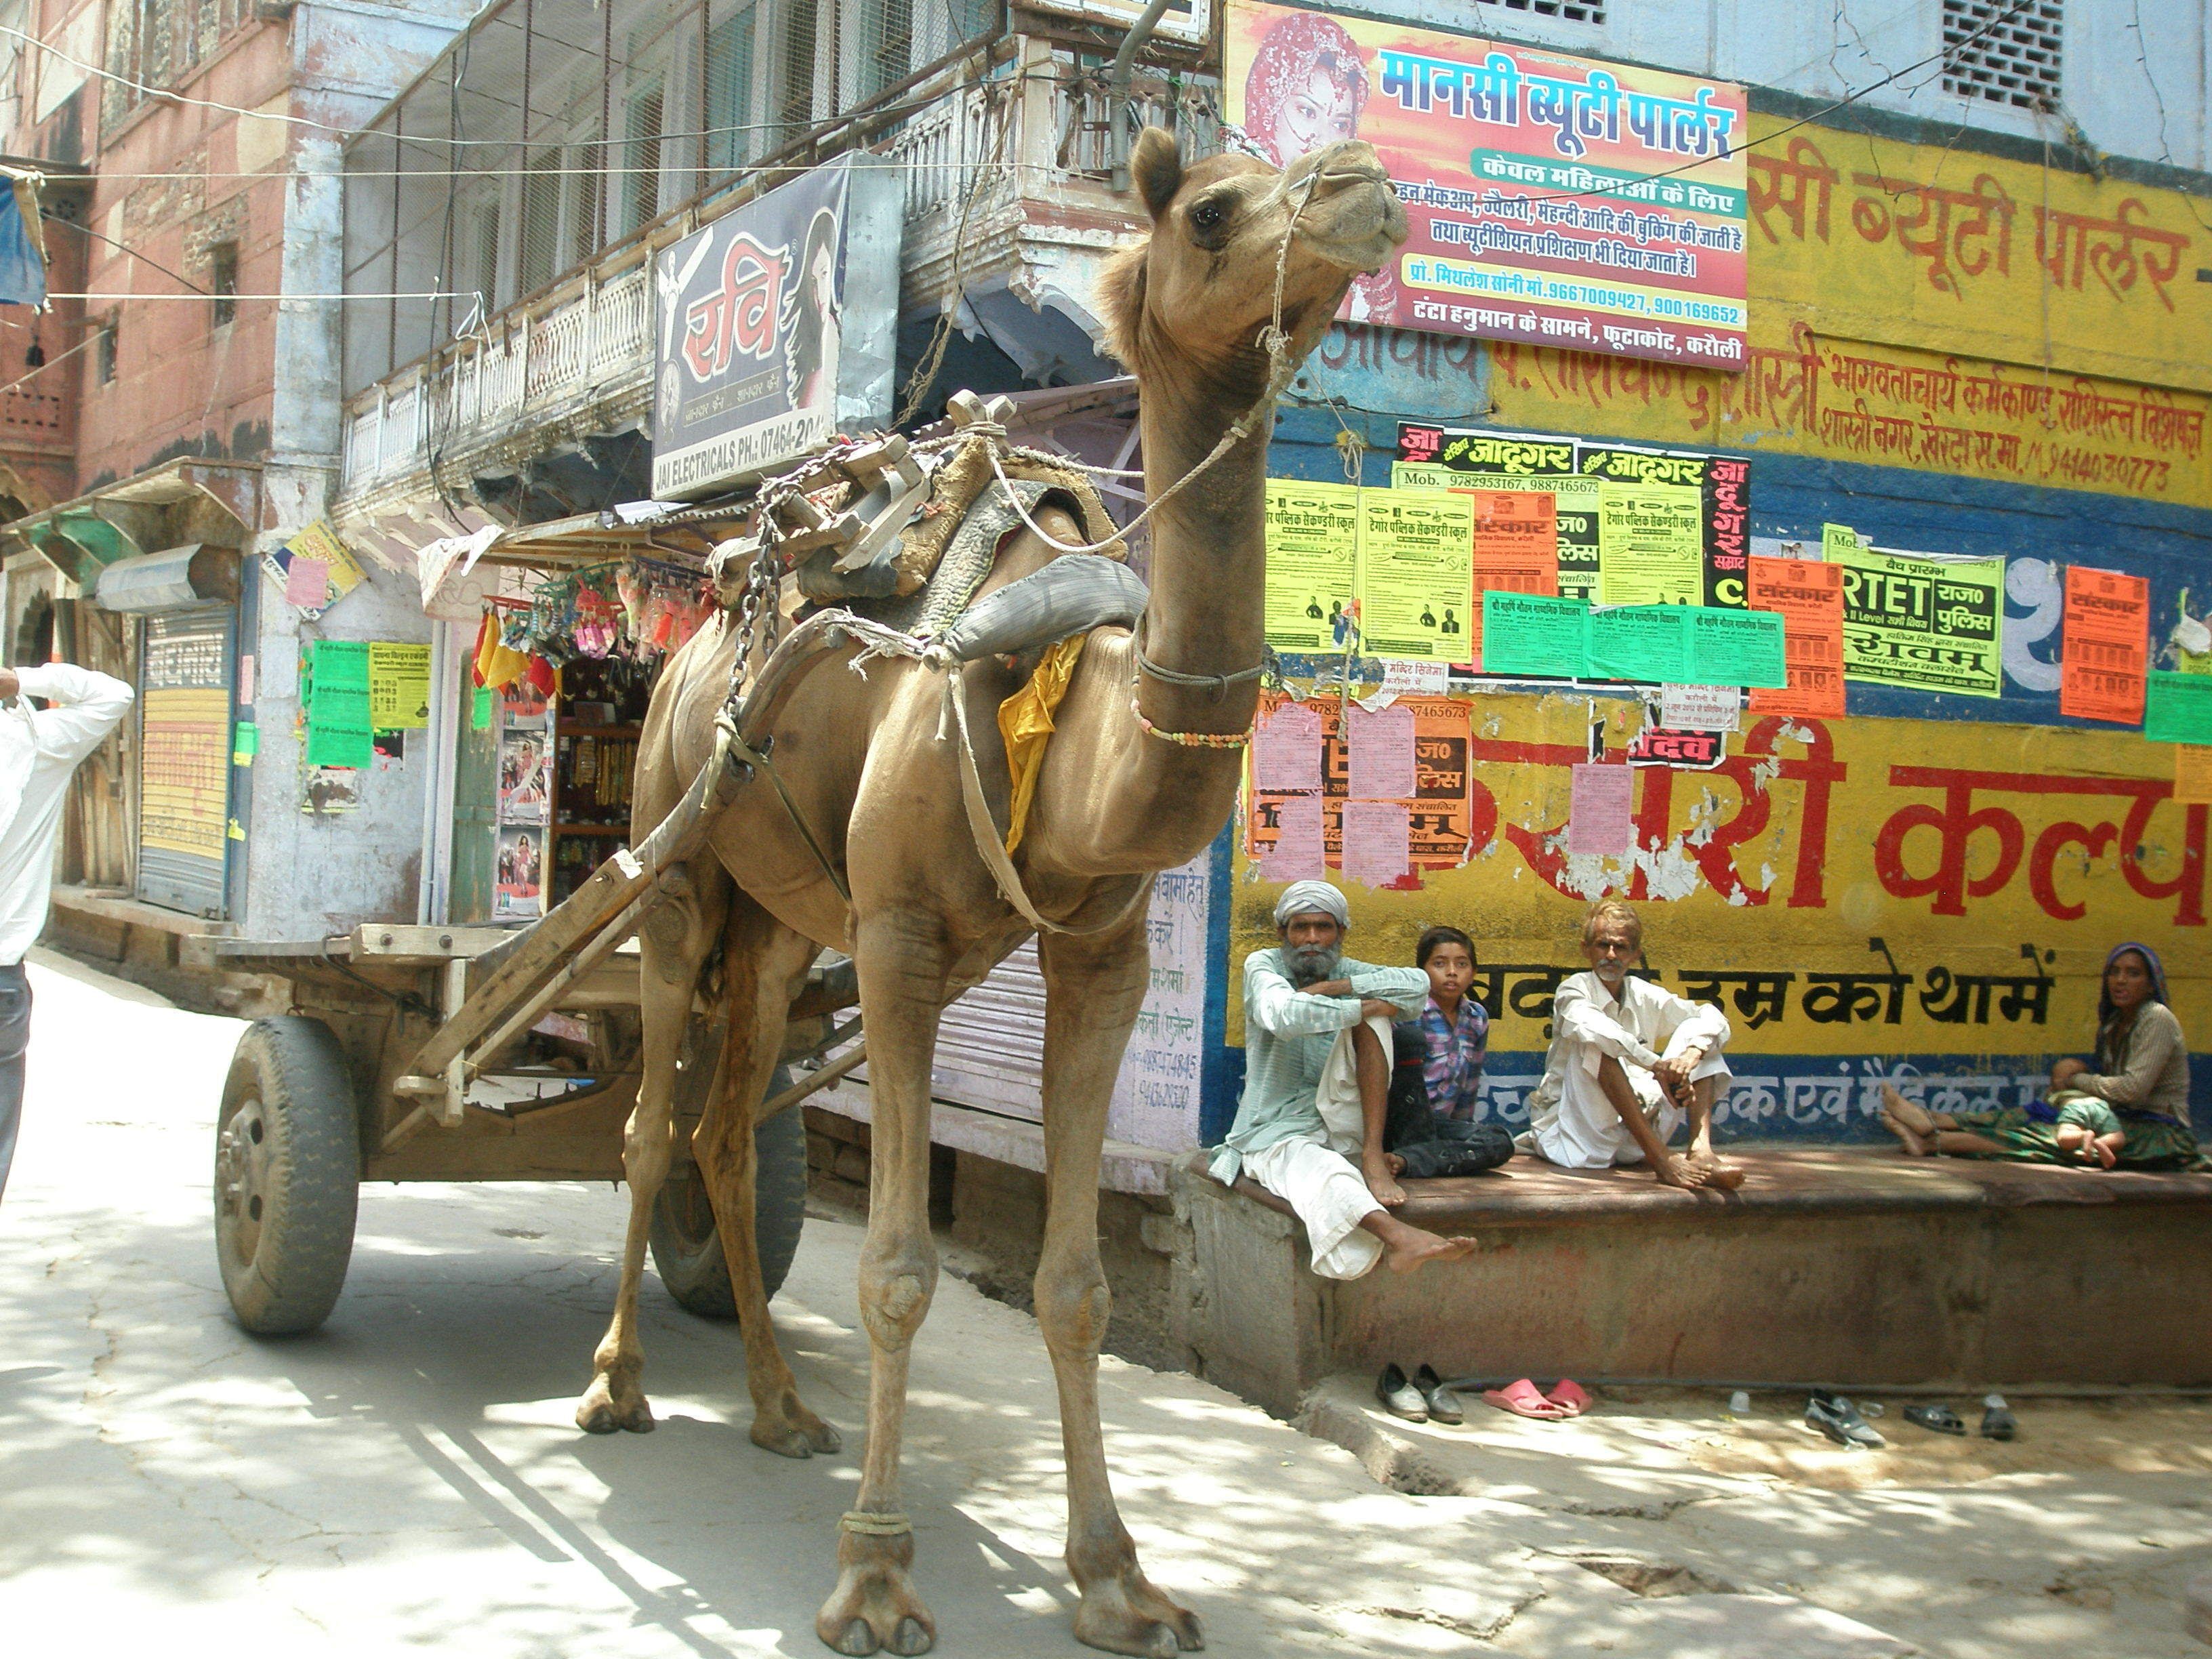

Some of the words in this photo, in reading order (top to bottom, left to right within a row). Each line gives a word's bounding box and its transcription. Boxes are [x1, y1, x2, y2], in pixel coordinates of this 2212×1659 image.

[1378, 48, 1524, 127] मानसी
[1525, 70, 1624, 161] ब्यूटी
[1626, 87, 1737, 162] पार्लर
[1481, 155, 1547, 182] केवल
[1550, 167, 1660, 201] महिलाओं
[1660, 184, 1685, 204] के
[1687, 186, 1736, 212] लिए
[1394, 180, 1420, 204] हन
[1422, 179, 1481, 218] मेकअप,
[1536, 199, 1581, 228] मेहन्दी
[1581, 205, 1616, 233] आदि
[1617, 209, 1637, 237] की
[1637, 211, 1678, 245] बुकिंग
[1677, 219, 1698, 245] की
[1698, 225, 1732, 253] जाती
[1730, 225, 1744, 253] है
[1431, 219, 1461, 244] तथा
[1461, 220, 1535, 256] ब्यूटीशियन
[1534, 229, 1594, 262] प्रशिक्षण
[1594, 239, 1614, 265] भी
[1613, 241, 1645, 269] दिया
[1645, 251, 1680, 275] जाता
[1852, 173, 2017, 301] ब्यूटी
[2033, 197, 2191, 313] पार्लर
[1409, 260, 1432, 282] प्रो.
[1435, 262, 1490, 290] मिथलेश
[1490, 271, 1524, 295] सोनी
[682, 231, 792, 383] रवि
[1450, 304, 1516, 332] हनुमान
[1517, 310, 1538, 333] के
[1540, 316, 1599, 344] सामने,
[1601, 325, 1683, 356] फूटाकोट,
[1685, 332, 1743, 361] करौली
[1820, 398, 1872, 454] शास्त्री
[655, 462, 670, 492] JAI
[672, 440, 736, 487] ELECTRICALS
[1468, 438, 1572, 475] जादूगर
[1606, 452, 1705, 486] जादूगर
[1404, 472, 1439, 486] Mob.
[1450, 475, 1525, 492] 9782953167,
[1530, 478, 1599, 493] 9887465673
[1336, 517, 1356, 533] स्कूल
[1368, 516, 1389, 533] टैगोर
[1389, 519, 1416, 535] पब्लिक
[1449, 526, 1469, 543] स्कूल
[1605, 510, 1624, 526] टैगोर
[1625, 512, 1650, 527] पब्लिक
[1679, 516, 1698, 533] स्कूल
[1556, 537, 1599, 562] लिस
[1714, 554, 1746, 571] सम्राट
[1715, 578, 1749, 607] C.
[1843, 567, 1931, 617] RTET
[1858, 611, 1885, 625] Level
[1937, 605, 1994, 634] पुलिस
[1389, 661, 1413, 675] मन्दिर
[1415, 662, 1443, 676] सिनेमा
[1410, 705, 1466, 718] 7465673
[1415, 763, 1463, 789] लिस
[1416, 801, 1457, 811] संचालित
[1801, 937, 1914, 1025] को
[1919, 943, 2055, 1025] थामें
[1784, 1061, 1854, 1125] एवं
